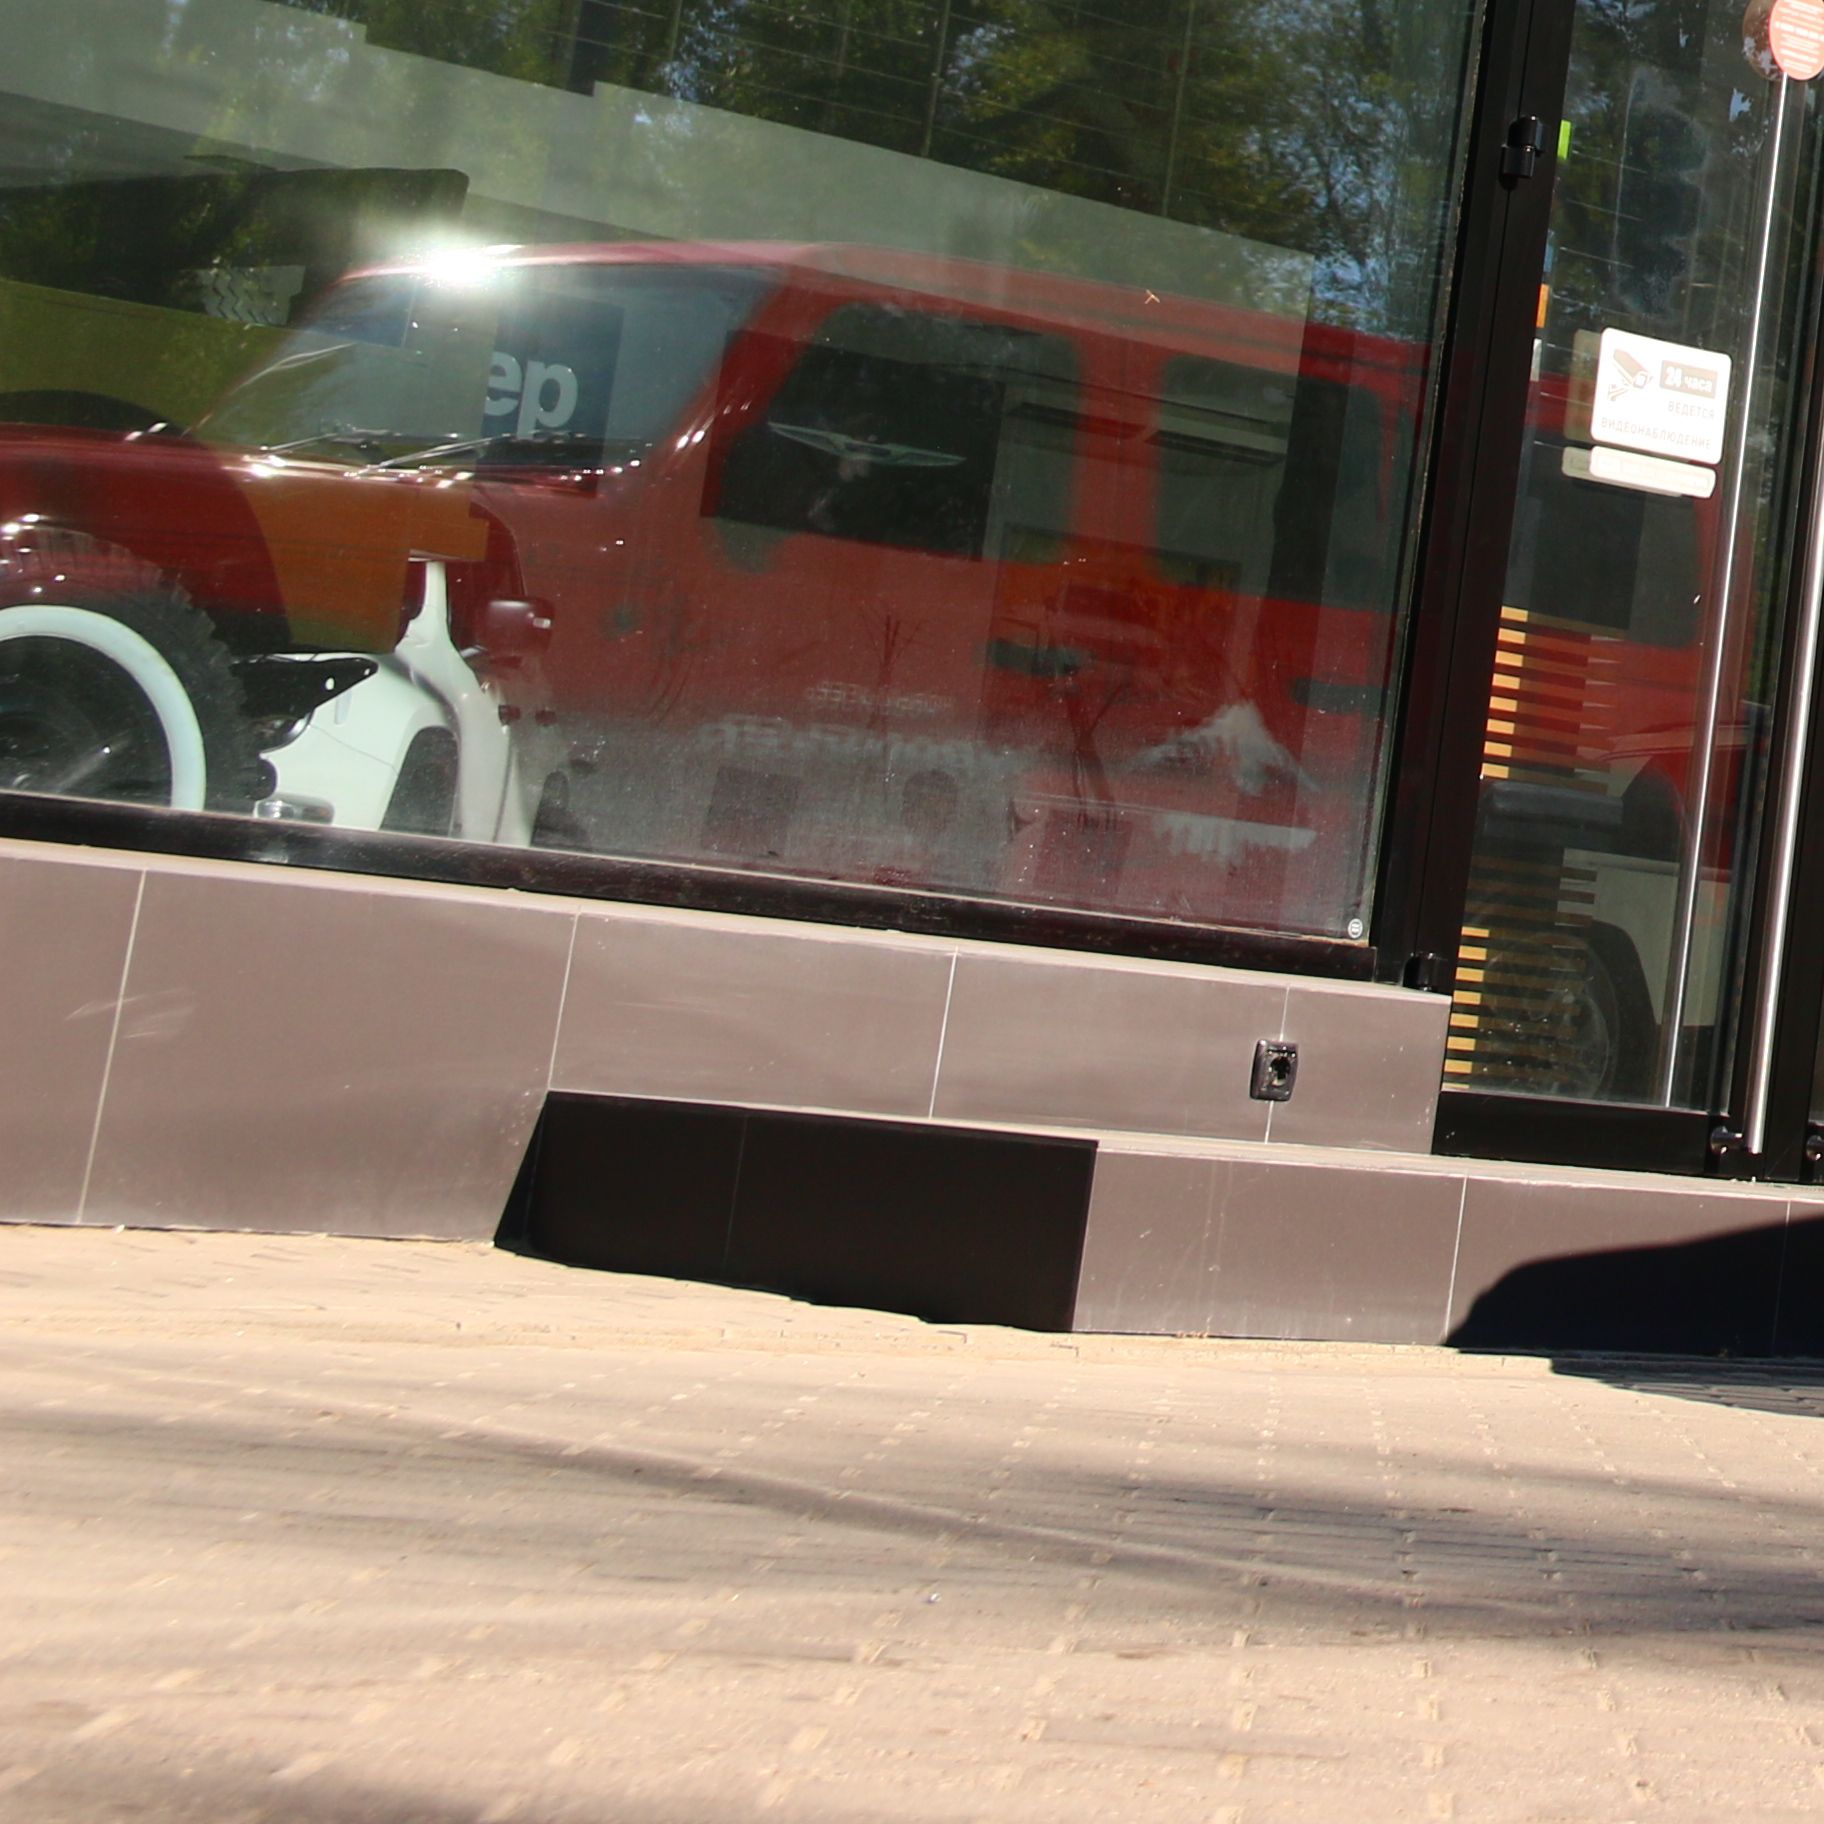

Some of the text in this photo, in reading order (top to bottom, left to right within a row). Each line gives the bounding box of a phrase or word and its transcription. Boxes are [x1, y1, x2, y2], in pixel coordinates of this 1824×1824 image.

[1664, 366, 1714, 394] 24 часа
[1667, 400, 1715, 420] ВЕДЕТСЯ
[1601, 416, 1712, 450] ВИДЕОНАБЛЮДЕНИЕ
